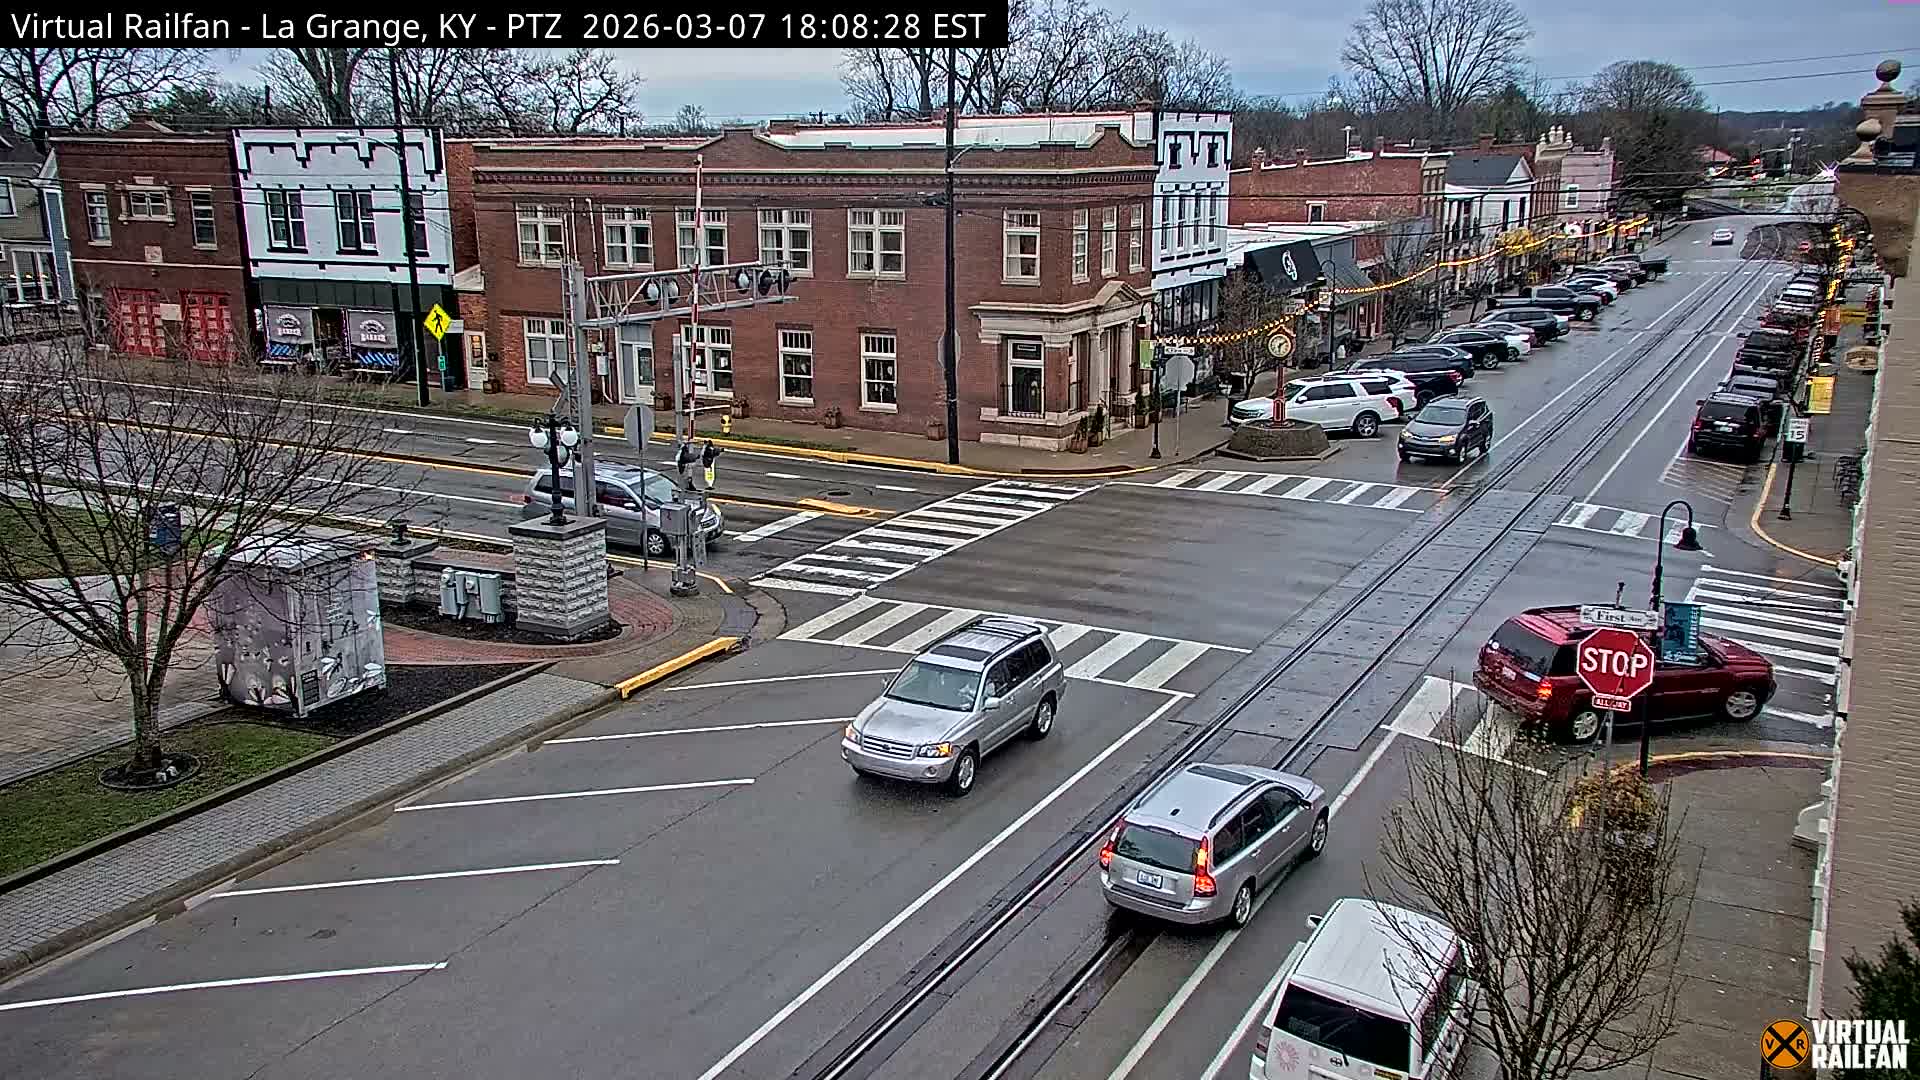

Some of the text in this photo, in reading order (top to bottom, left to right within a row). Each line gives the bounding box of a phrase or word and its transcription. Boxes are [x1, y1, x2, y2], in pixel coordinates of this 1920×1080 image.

[1790, 430, 1805, 440] 15
[1597, 610, 1626, 623] First
[1582, 647, 1649, 678] STOP
[1596, 698, 1610, 707] ALL
